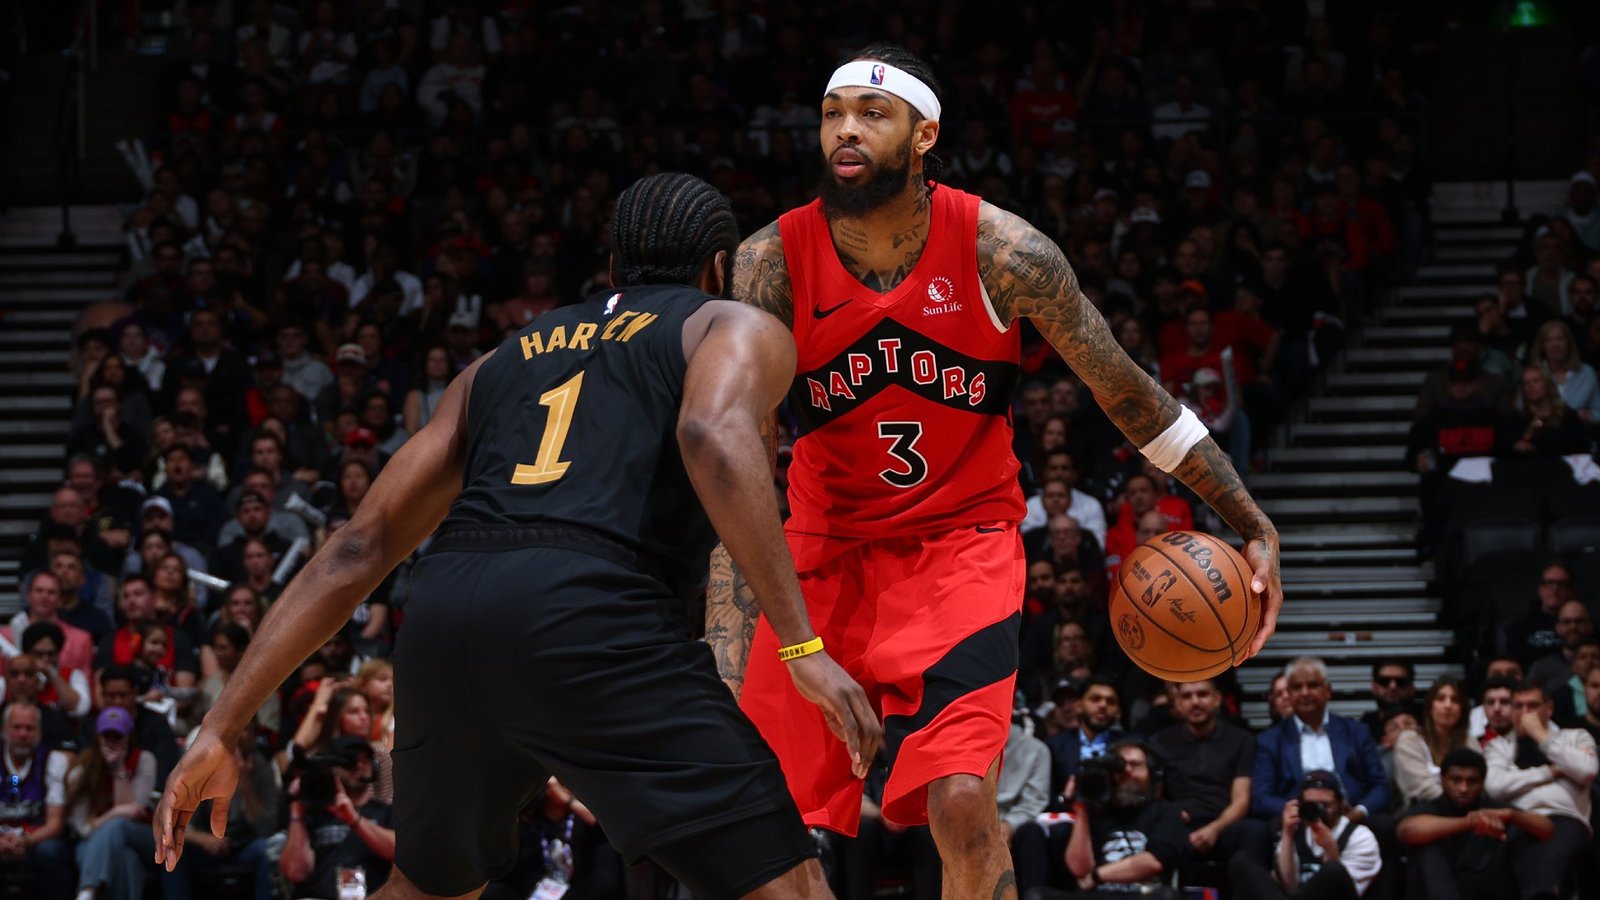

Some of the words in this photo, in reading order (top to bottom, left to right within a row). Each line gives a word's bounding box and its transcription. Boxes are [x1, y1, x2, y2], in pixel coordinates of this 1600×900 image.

[520, 310, 659, 361] HAREN
[923, 306, 943, 316] Sun
[944, 301, 963, 313] Life
[807, 338, 986, 412] RAPTORS
[510, 370, 585, 484] 1
[877, 421, 929, 488] 3
[1161, 531, 1233, 604] Wilson
